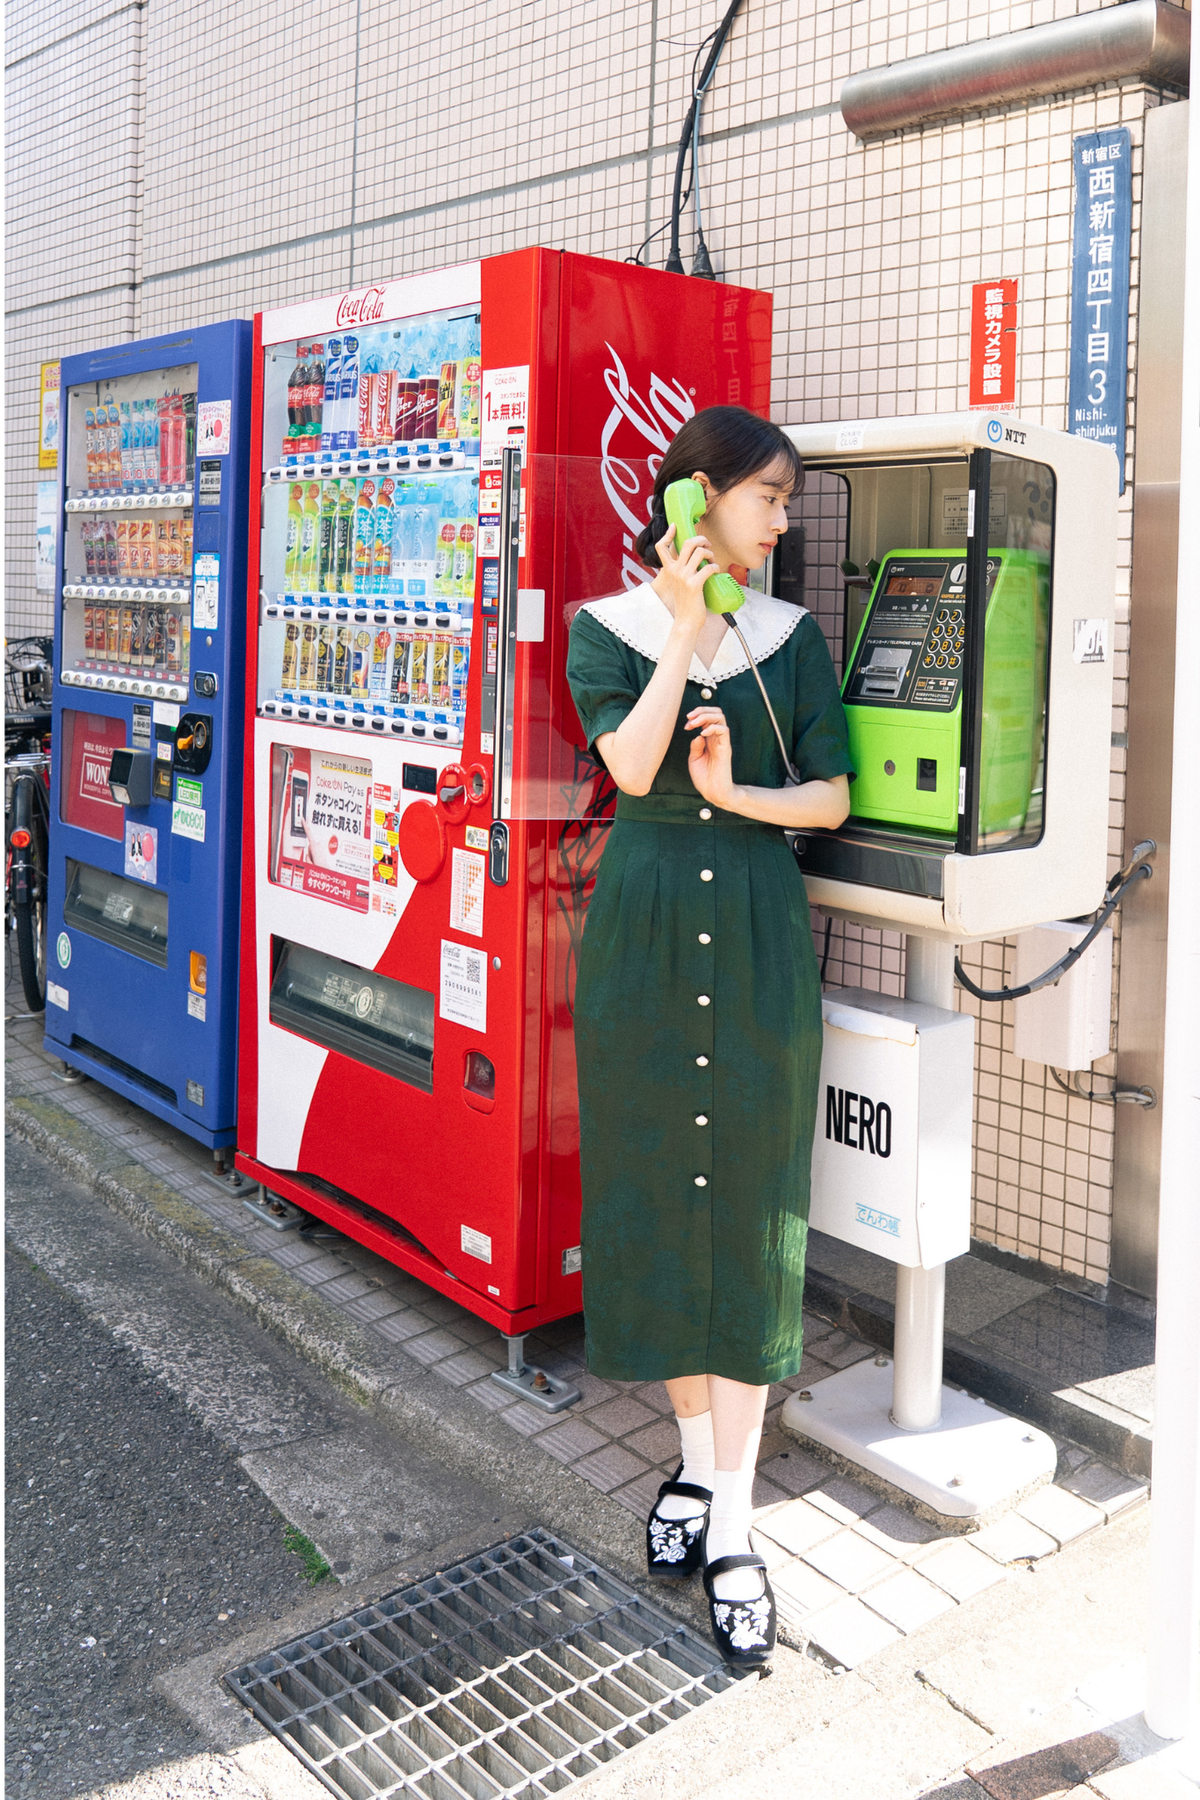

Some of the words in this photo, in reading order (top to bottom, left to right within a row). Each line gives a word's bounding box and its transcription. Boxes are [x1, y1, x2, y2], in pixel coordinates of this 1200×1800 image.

[1081, 143, 1122, 165] 新宿区
[1086, 165, 1116, 405] 西新宿四丁目3
[336, 286, 388, 328] Coca-Cola
[982, 288, 1004, 396] 監視カメラ設置
[484, 391, 526, 422] 1本無料!
[1075, 407, 1108, 422] Nishi-
[1004, 428, 1027, 445] NTT
[1074, 424, 1118, 440] shinjuku
[86, 761, 110, 787] WON
[315, 775, 332, 789] Coke
[343, 781, 357, 798] Pay
[314, 792, 362, 815] ボタンやコインに
[312, 809, 362, 836] 触れずに買える!
[825, 1084, 892, 1159] NERO
[857, 1206, 899, 1235] でんわ帳
